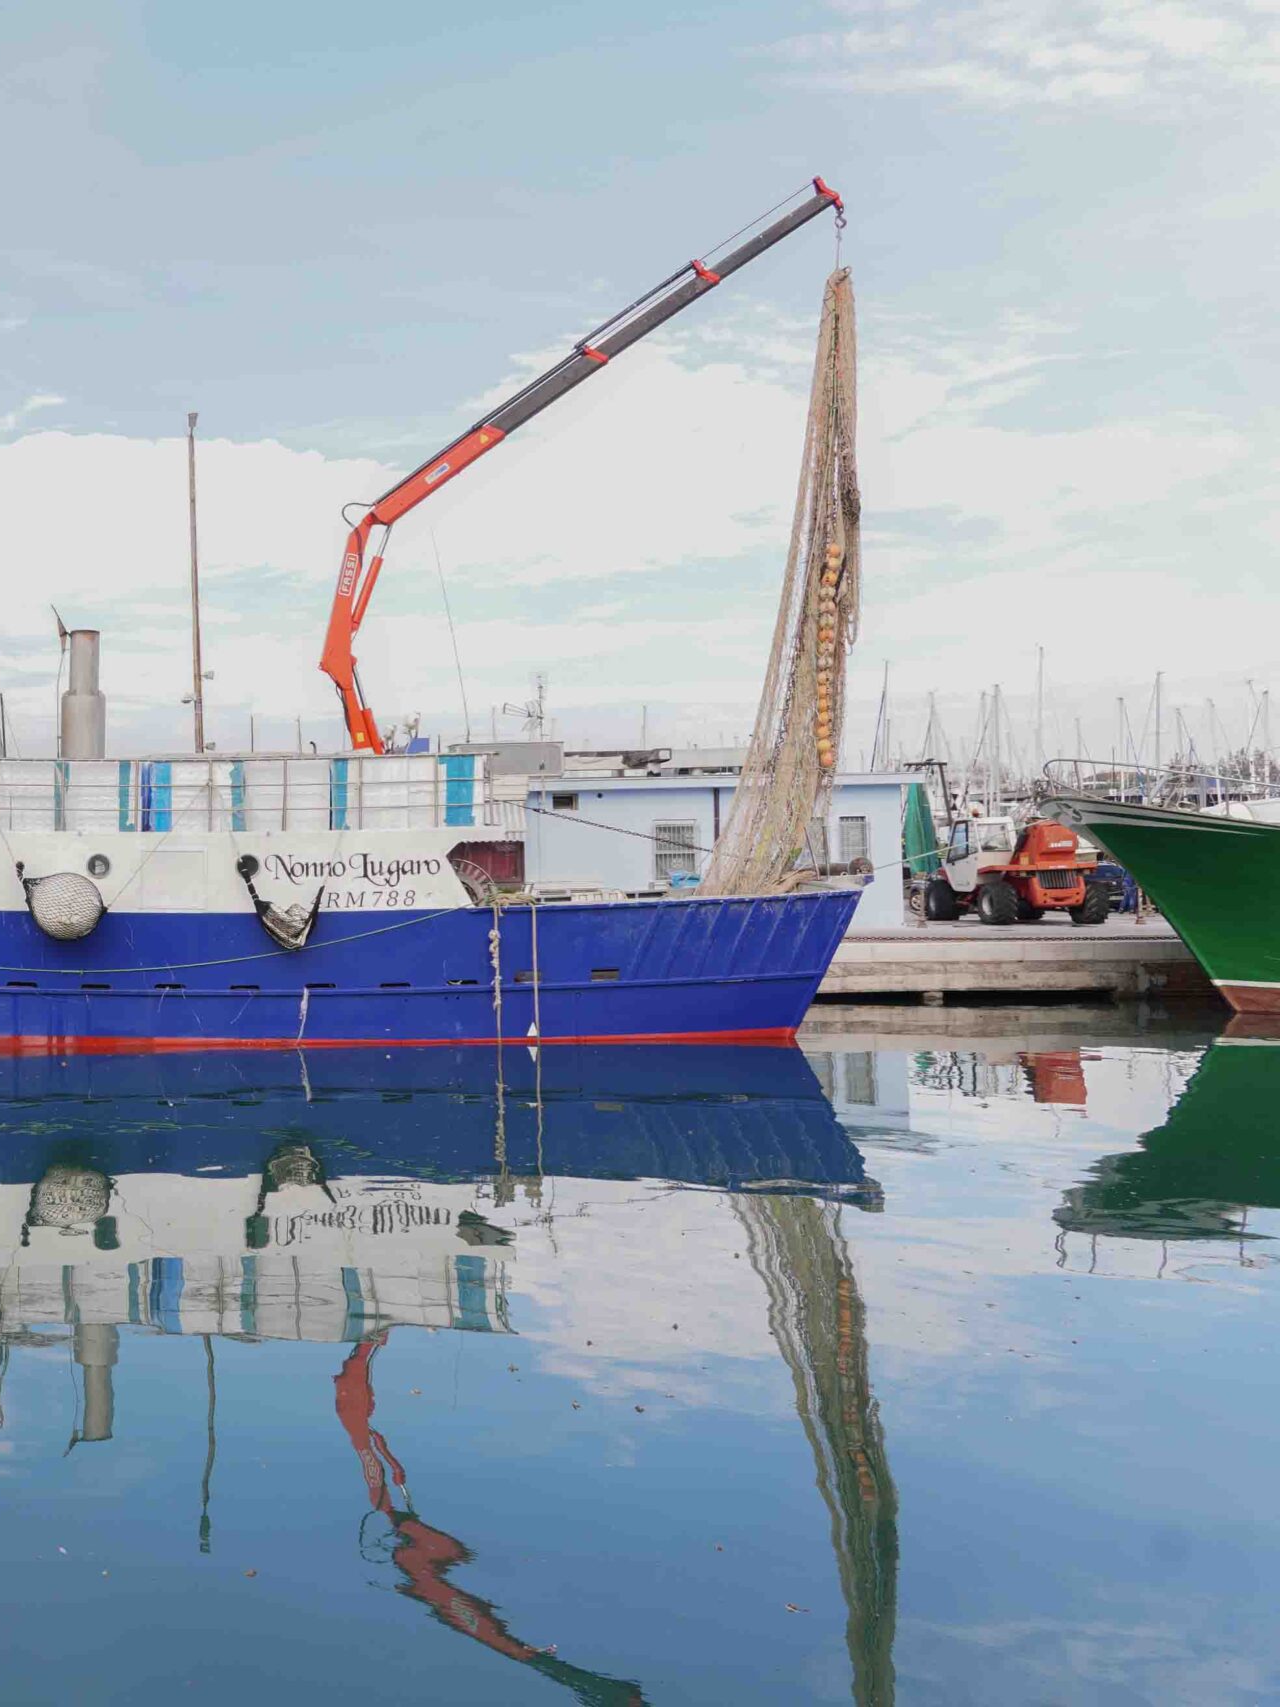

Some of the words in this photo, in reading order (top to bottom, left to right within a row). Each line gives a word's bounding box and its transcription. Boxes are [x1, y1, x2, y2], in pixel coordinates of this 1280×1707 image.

[341, 555, 357, 592] FASSI
[264, 854, 346, 885] Nonno
[348, 853, 441, 887] Lugaro
[372, 890, 416, 908] 788
